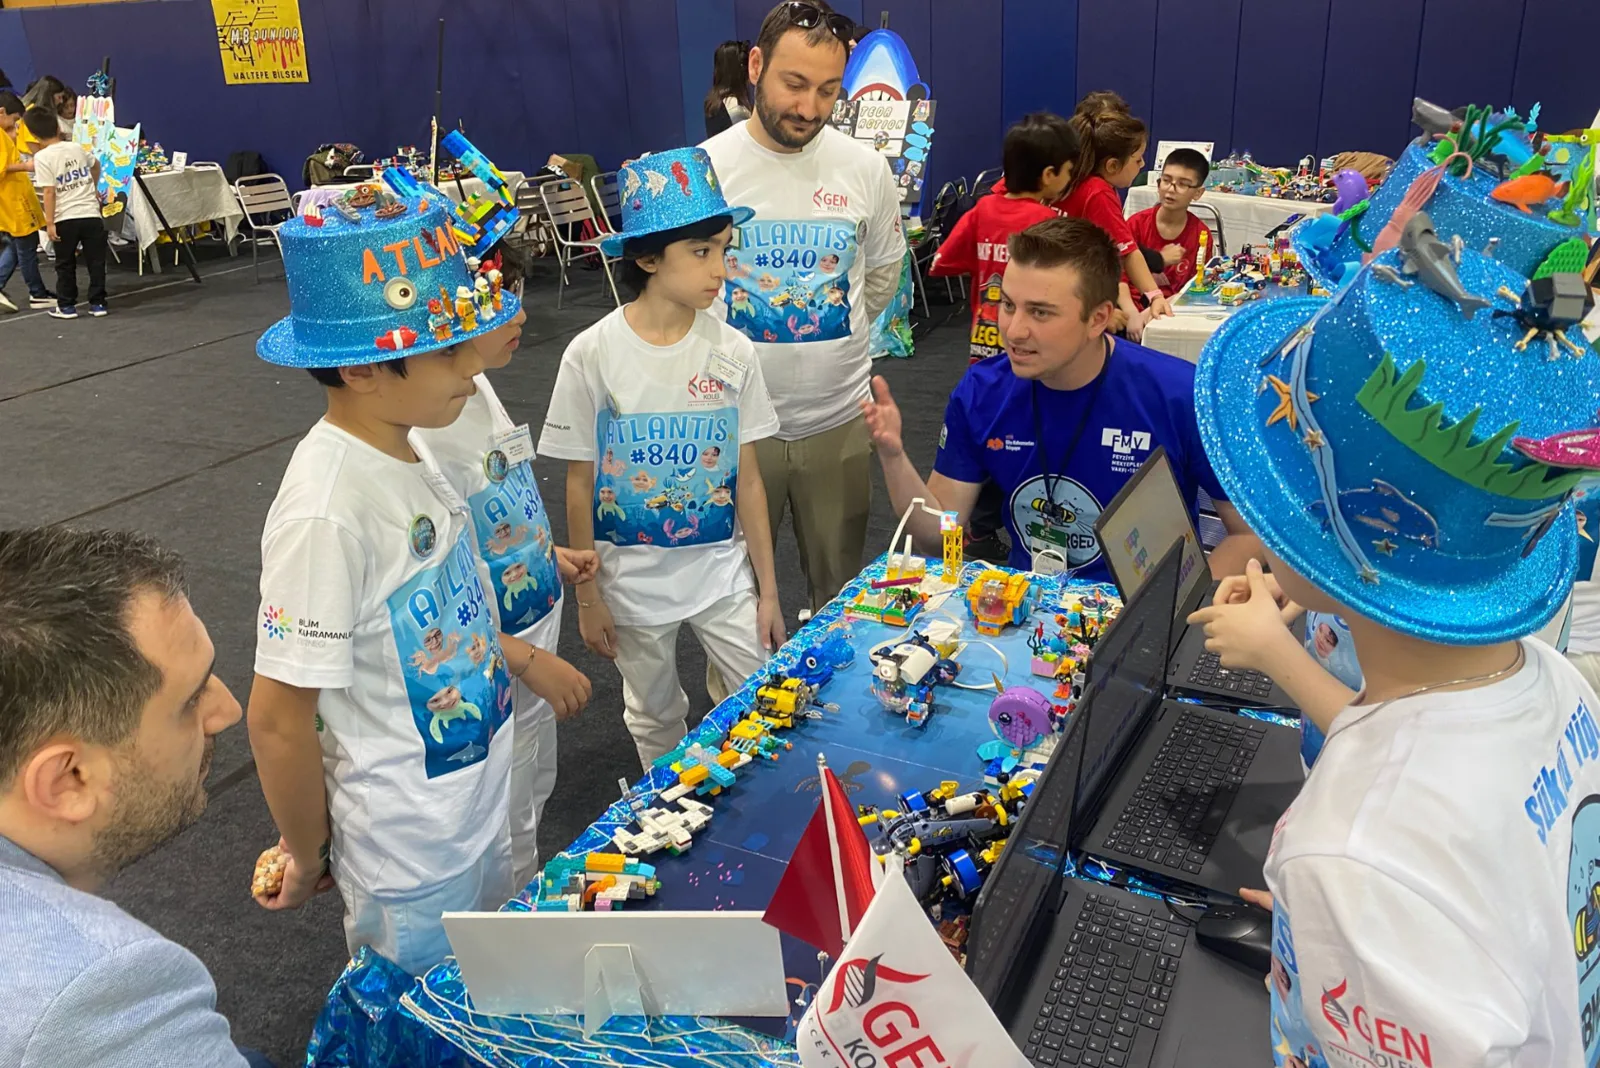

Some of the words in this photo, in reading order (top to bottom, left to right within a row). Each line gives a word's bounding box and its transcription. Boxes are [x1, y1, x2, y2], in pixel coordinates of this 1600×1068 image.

[230, 27, 250, 46] MB
[253, 26, 299, 43] JUNIOR
[233, 71, 269, 80] MALTEPE
[272, 69, 303, 79] BİLSEM
[857, 119, 905, 130] ACTION
[56, 166, 89, 185] YUSU
[823, 193, 848, 207] GEN
[741, 223, 850, 250] TLANTİS
[362, 214, 459, 285] ATLAN
[754, 248, 818, 270] #840
[699, 378, 724, 393] GEN
[605, 414, 729, 445] ATLANTİS
[1112, 434, 1144, 450] FMV
[630, 443, 698, 467] #840
[1111, 460, 1143, 468] MEKTEPLE
[408, 532, 476, 630] ATLAN
[457, 575, 485, 627] #84
[862, 1001, 949, 1068] GE
[1353, 1004, 1433, 1068] GEN
[844, 1038, 877, 1068] KO
